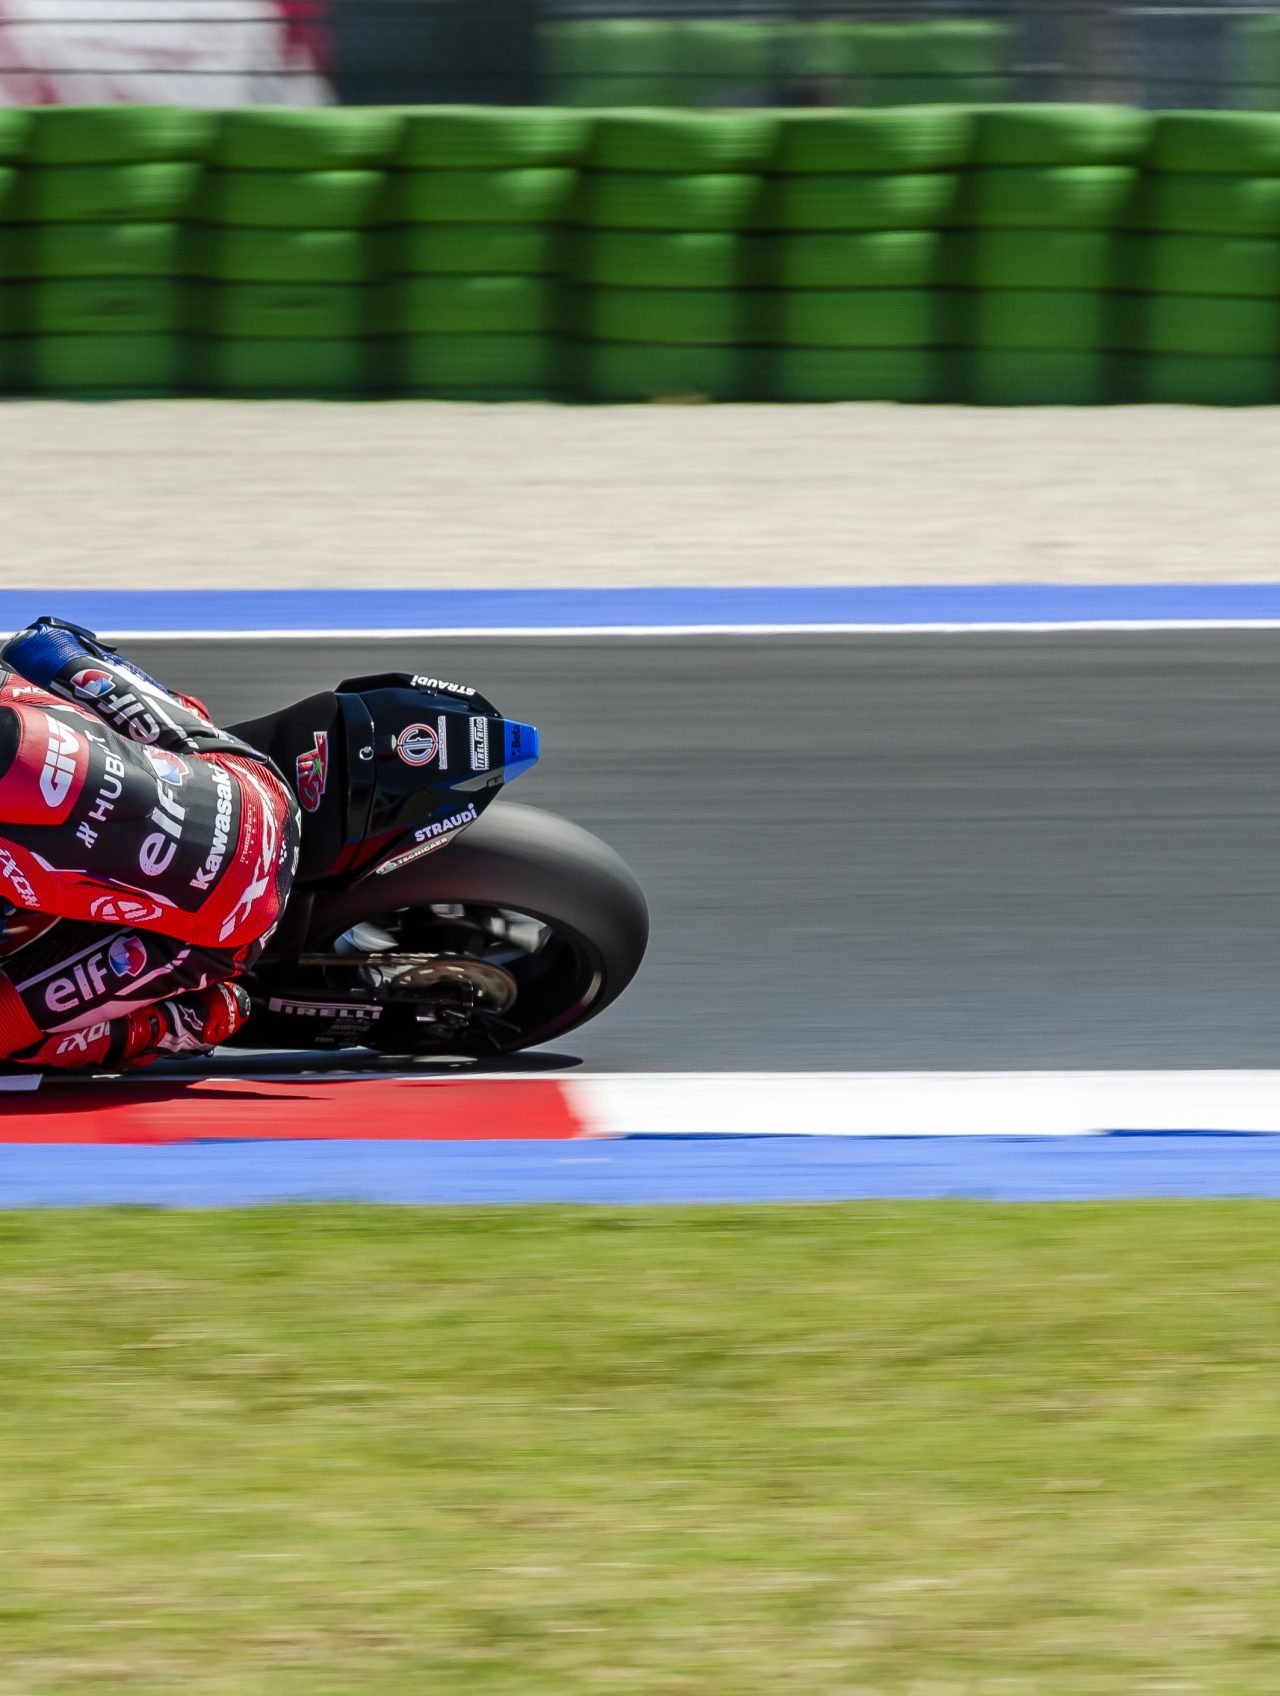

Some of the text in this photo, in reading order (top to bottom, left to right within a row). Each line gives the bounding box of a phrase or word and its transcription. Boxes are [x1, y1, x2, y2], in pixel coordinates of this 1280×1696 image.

[97, 693, 161, 744] elf
[139, 779, 185, 877] elf
[189, 763, 232, 890] Kawasaki
[45, 951, 108, 1012] elf
